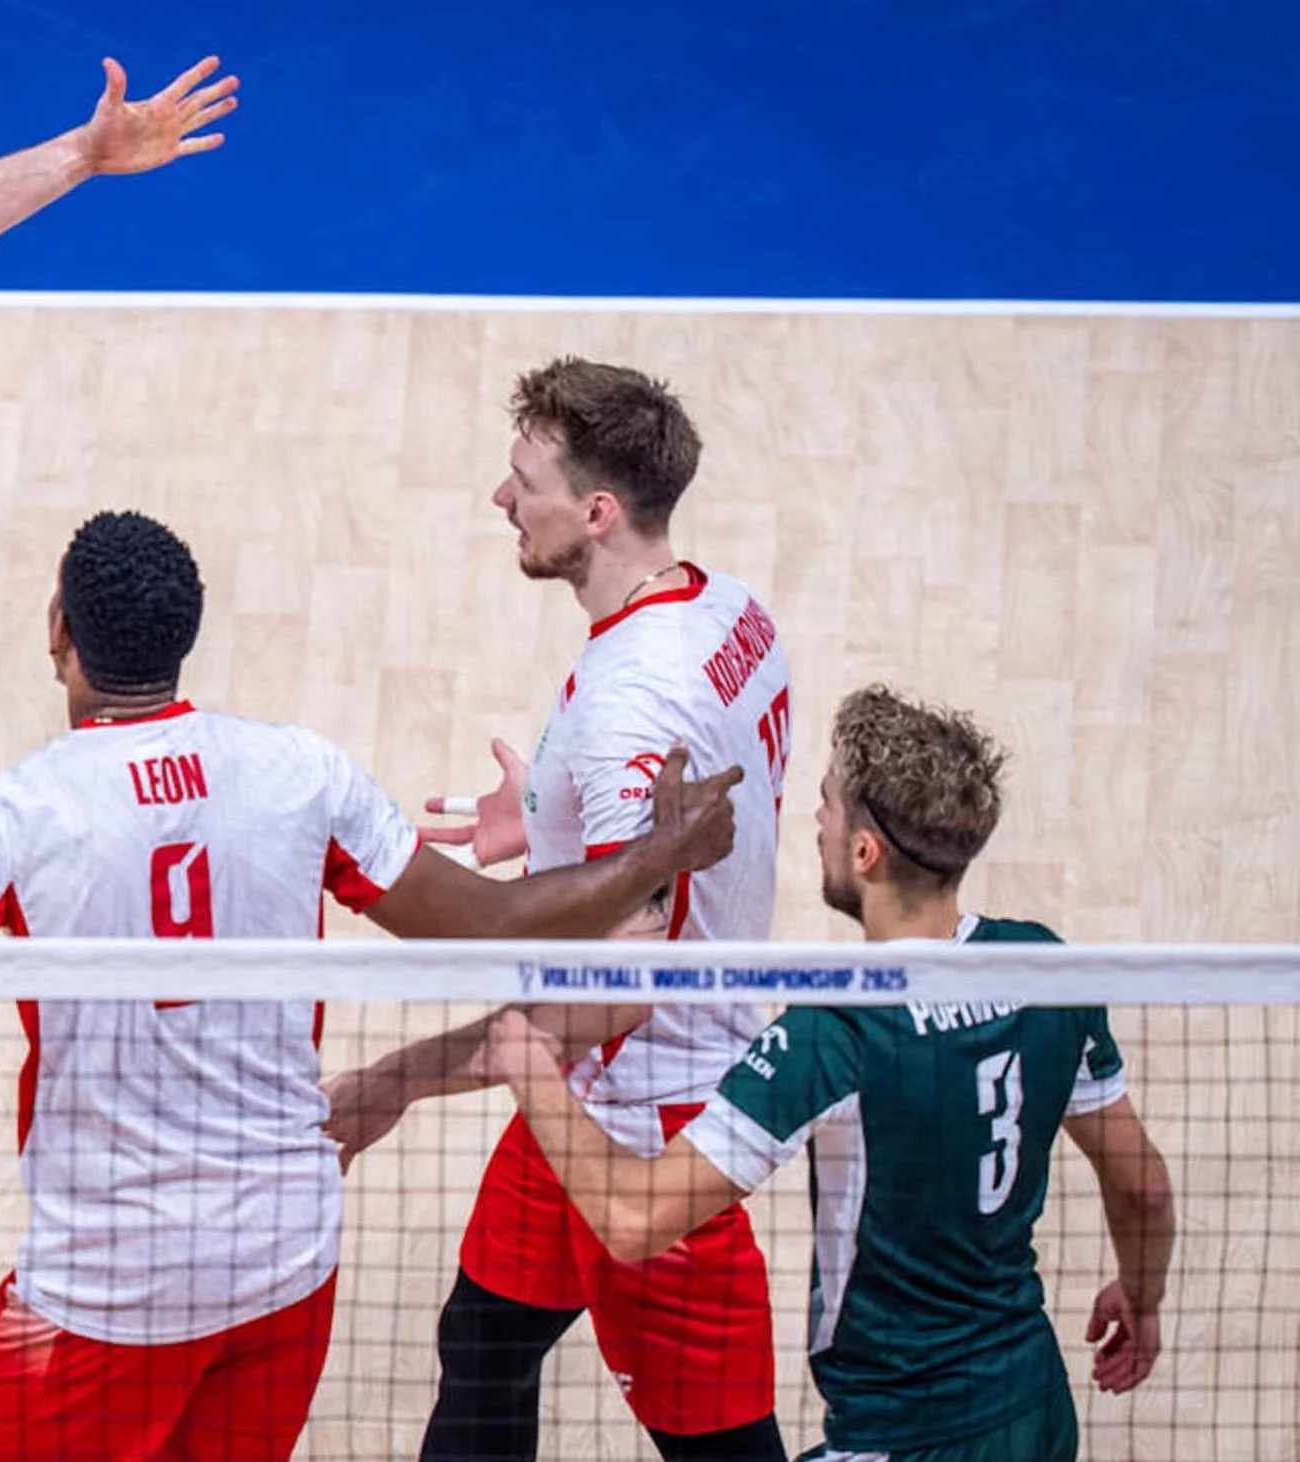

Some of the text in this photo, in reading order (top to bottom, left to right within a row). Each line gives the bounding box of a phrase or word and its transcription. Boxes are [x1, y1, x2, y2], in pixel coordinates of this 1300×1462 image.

[127, 753, 208, 806] LEON
[619, 787, 654, 800] ORL
[150, 842, 214, 1010] 9
[540, 965, 907, 991] VOLLEYBALL WORLD CHAMPIONSHIP 2025
[976, 1050, 1023, 1215] 3
